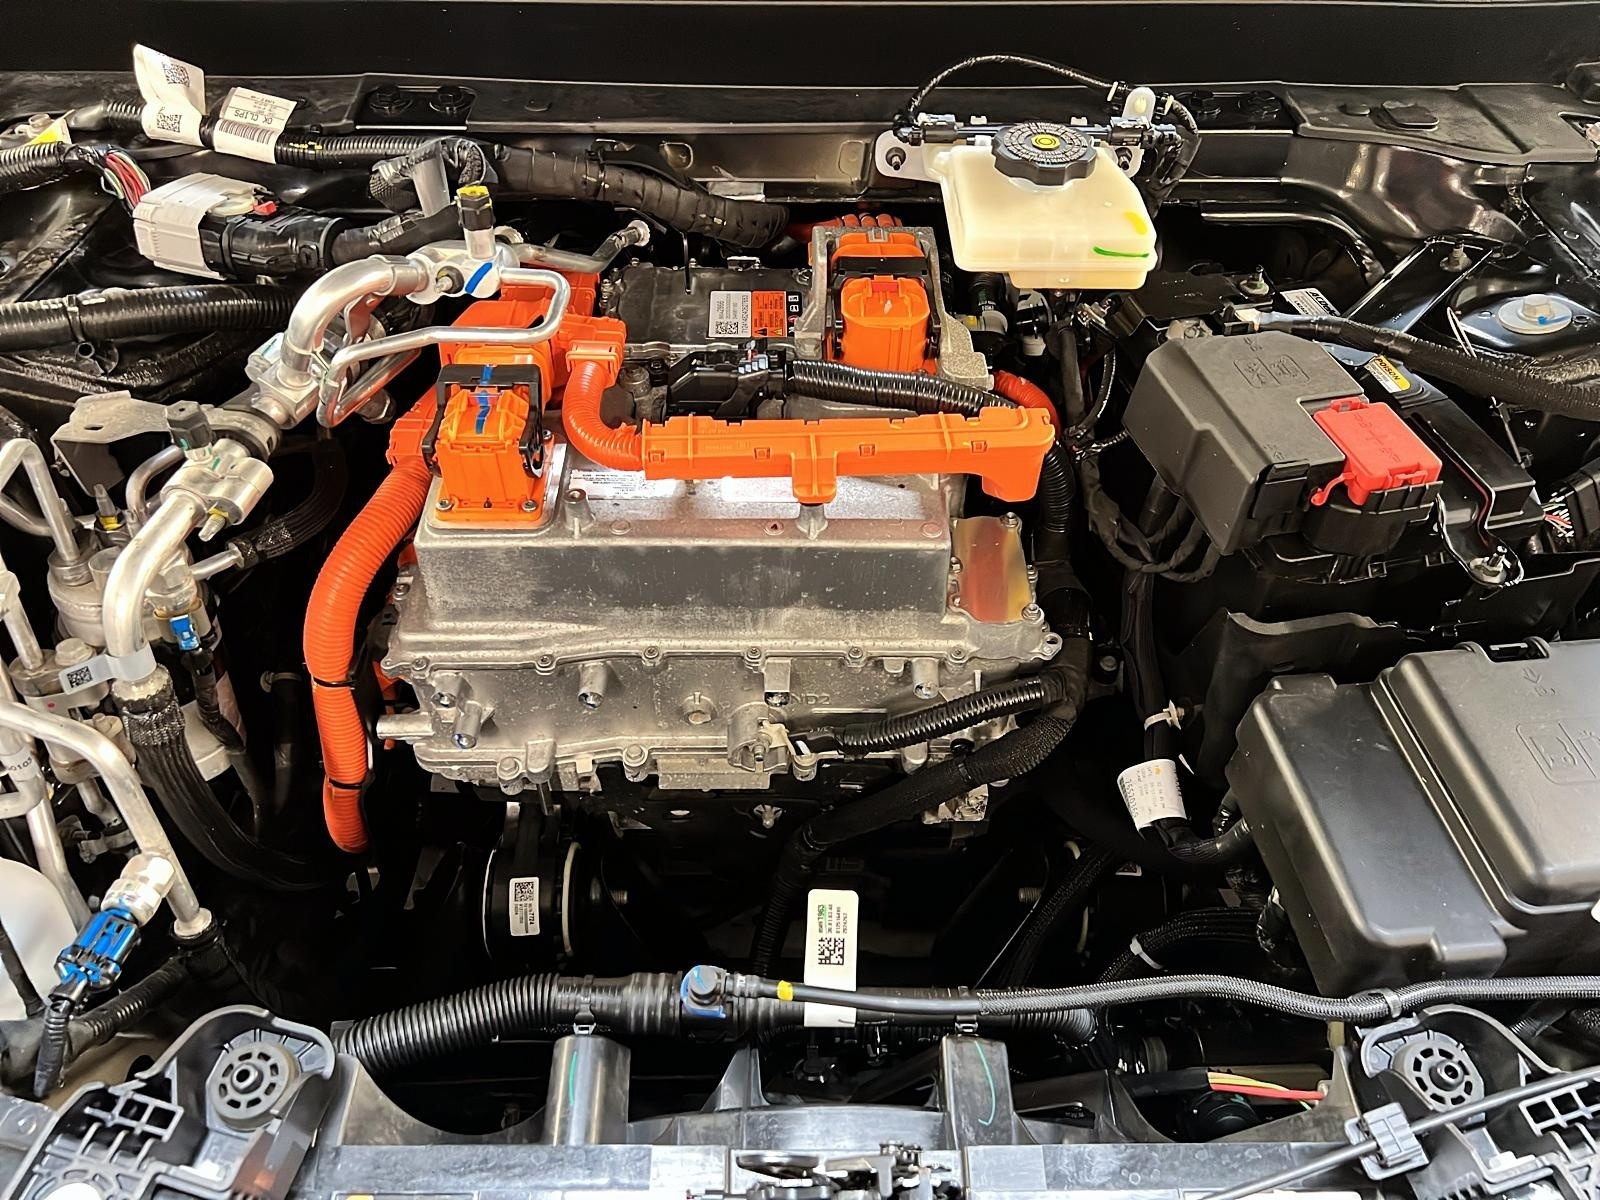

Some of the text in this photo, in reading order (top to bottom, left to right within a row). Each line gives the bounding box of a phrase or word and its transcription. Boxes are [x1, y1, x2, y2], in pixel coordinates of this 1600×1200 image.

[234, 109, 273, 125] OK CLIPS
[1376, 358, 1401, 381] POISON
